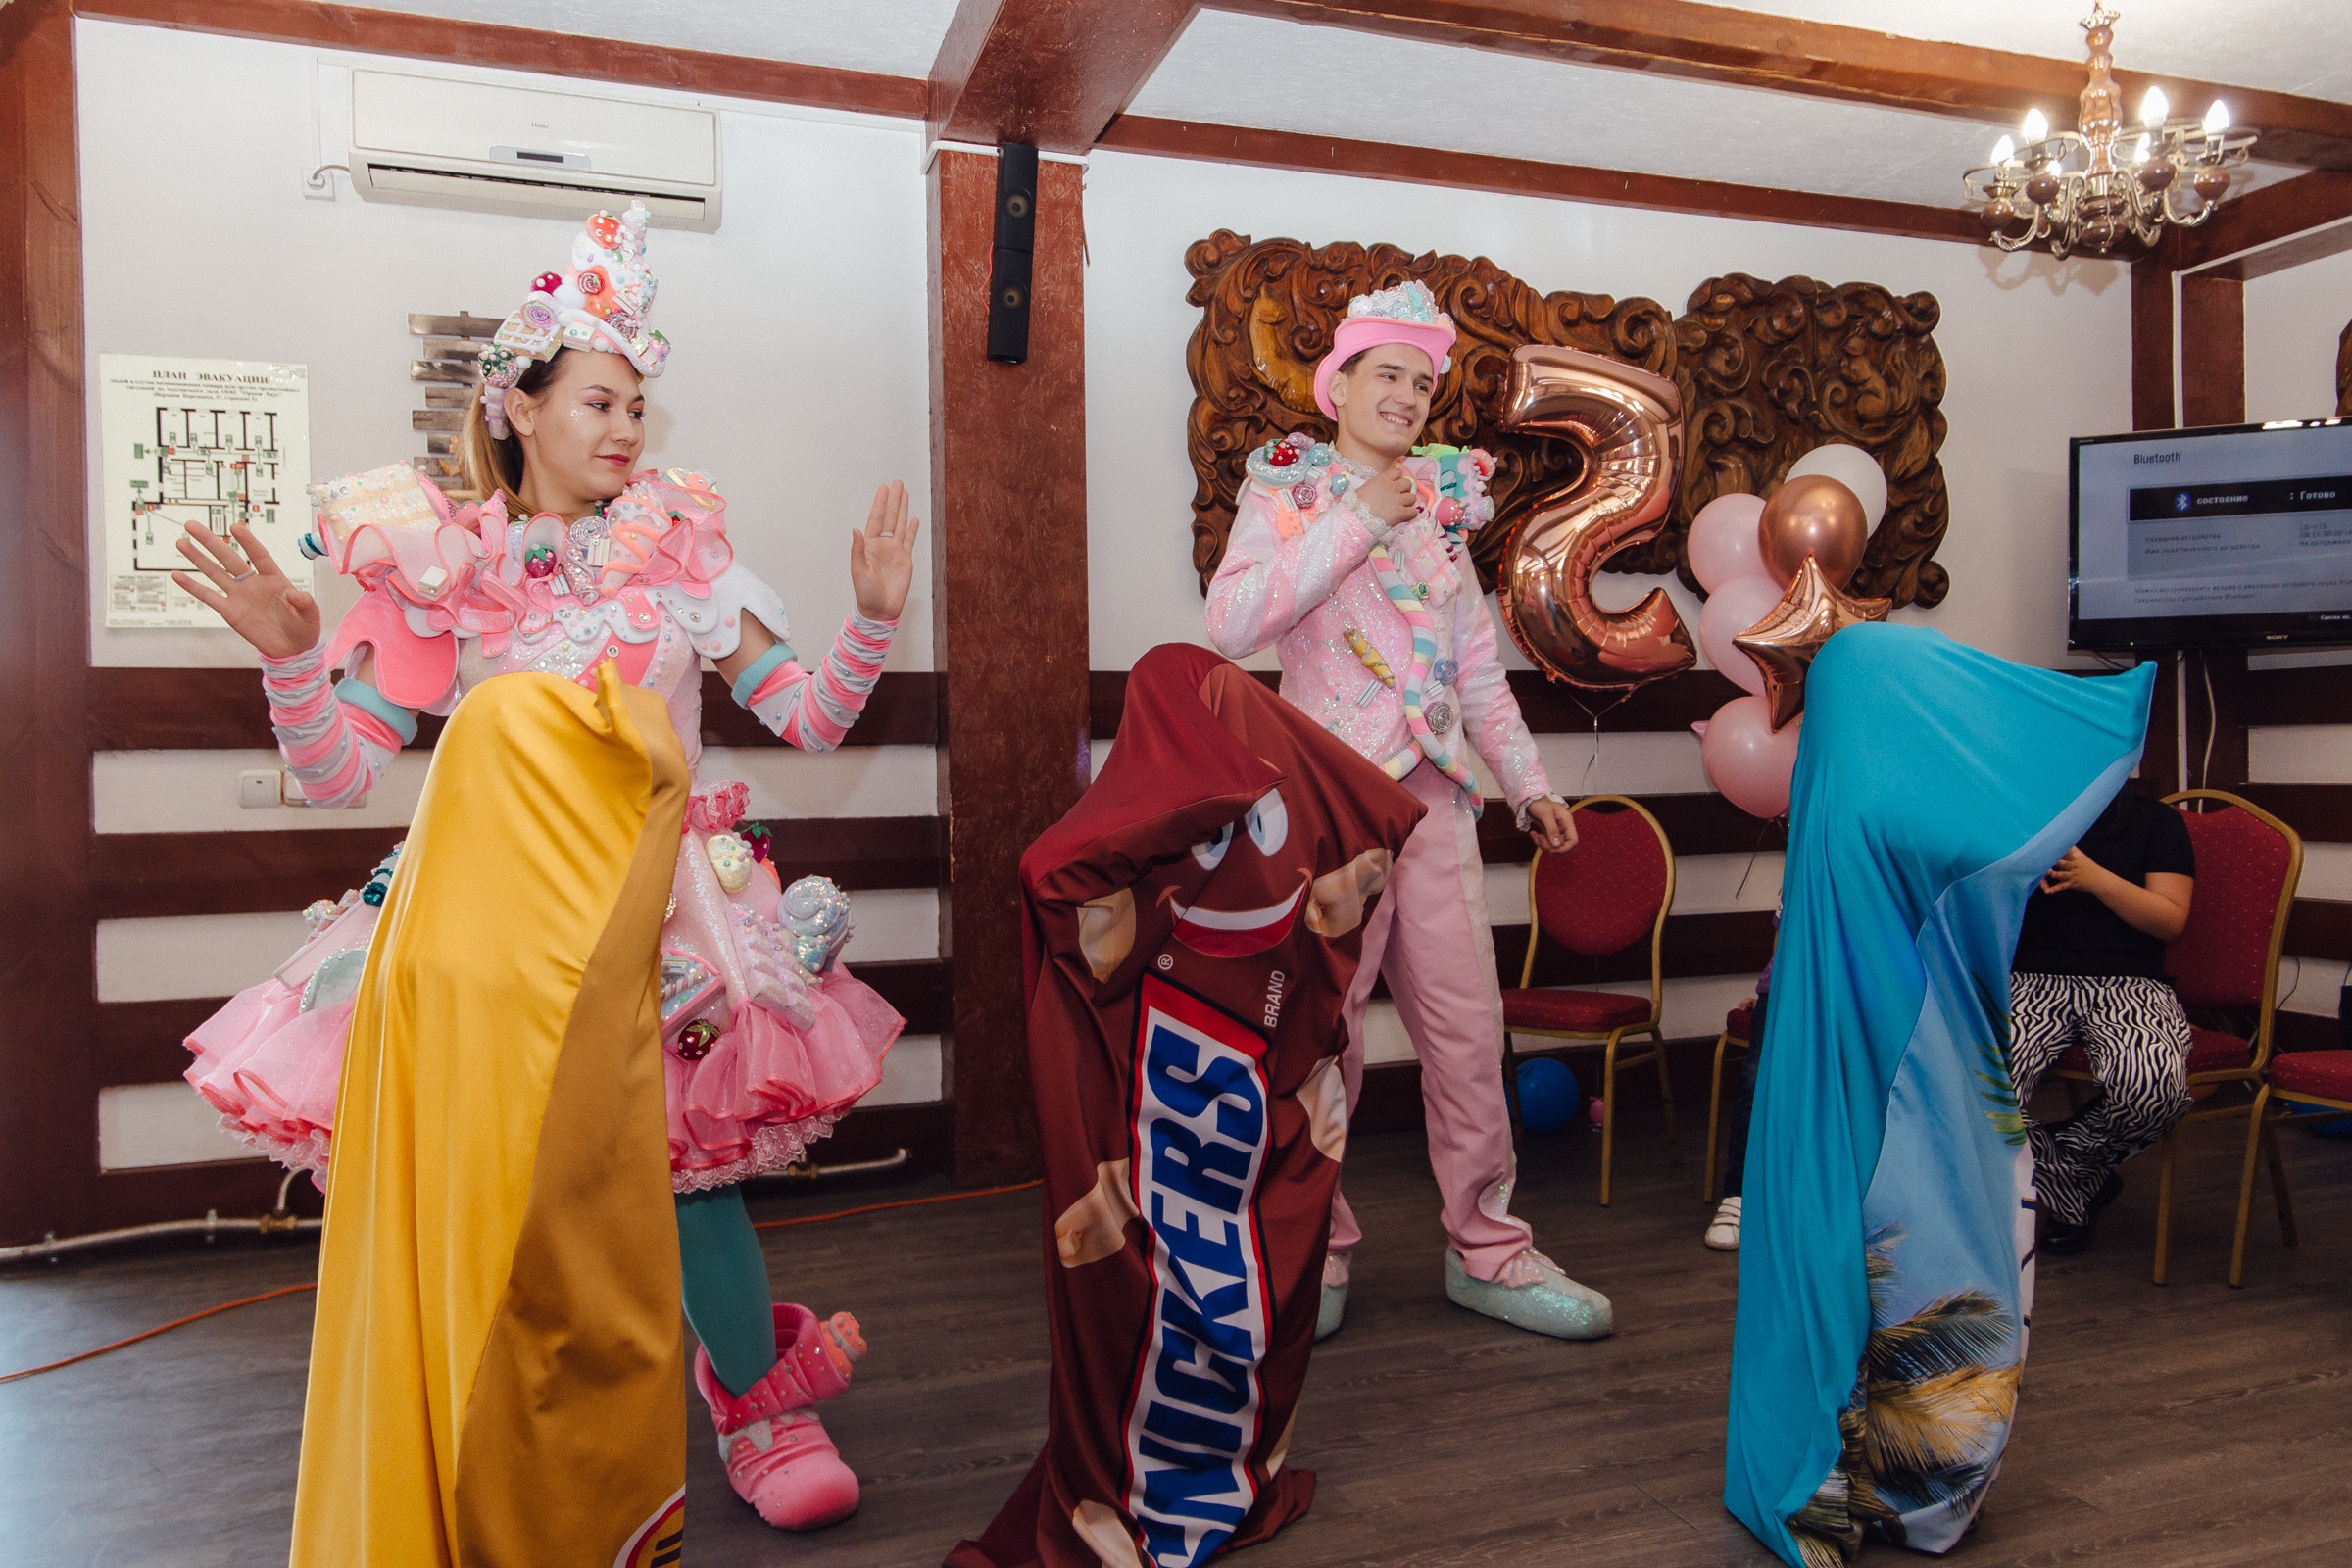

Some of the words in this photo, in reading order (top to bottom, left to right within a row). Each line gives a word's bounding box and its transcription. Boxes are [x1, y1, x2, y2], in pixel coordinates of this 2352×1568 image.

[153, 370, 187, 380] ПЛАН
[198, 372, 270, 384] ЭВАКУАЦИИ
[2133, 451, 2181, 465] Bluetooth
[2196, 494, 2249, 505] состояние
[2299, 490, 2336, 501] Готово
[1264, 970, 1285, 1028] BRAND
